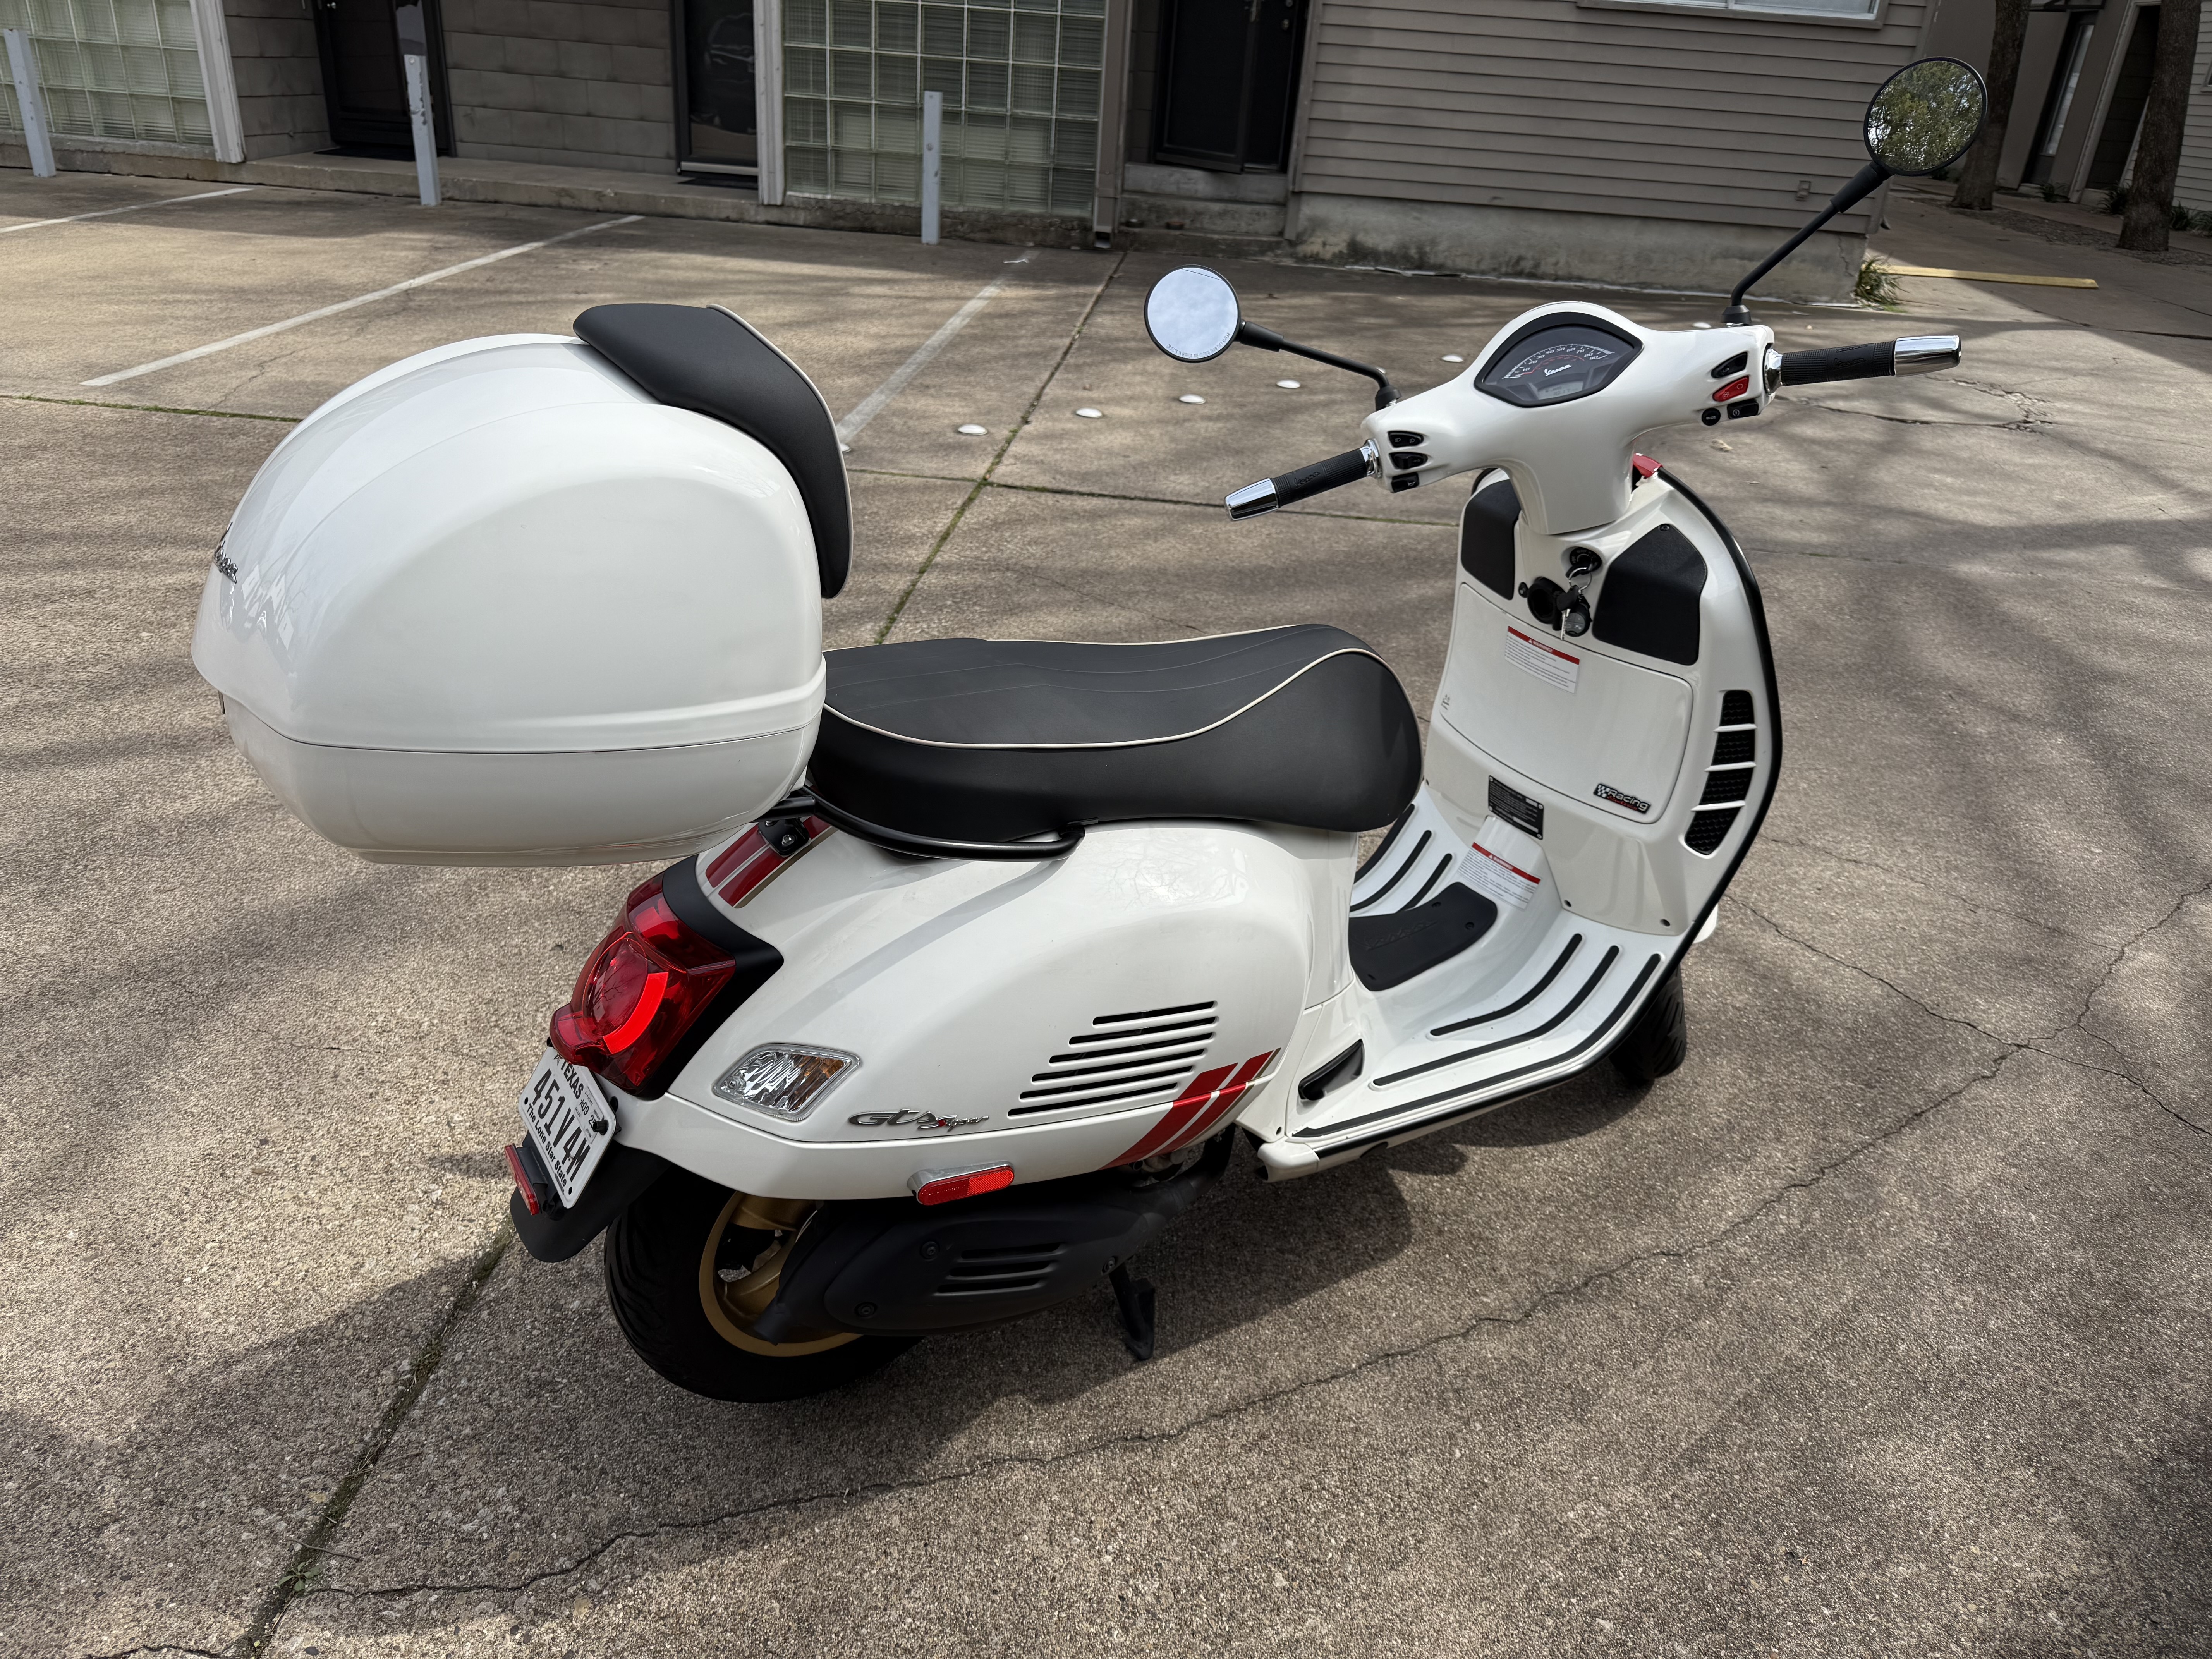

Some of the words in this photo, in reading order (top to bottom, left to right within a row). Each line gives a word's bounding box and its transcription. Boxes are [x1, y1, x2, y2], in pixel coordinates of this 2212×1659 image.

[1607, 790, 1649, 811] Racing
[561, 1060, 584, 1099] TEXAS
[532, 1068, 591, 1182] 451V4M
[582, 1102, 589, 1115] 09
[527, 1103, 536, 1123] The
[535, 1120, 546, 1144] Lone
[545, 1141, 556, 1162] Star
[554, 1161, 567, 1187] State
